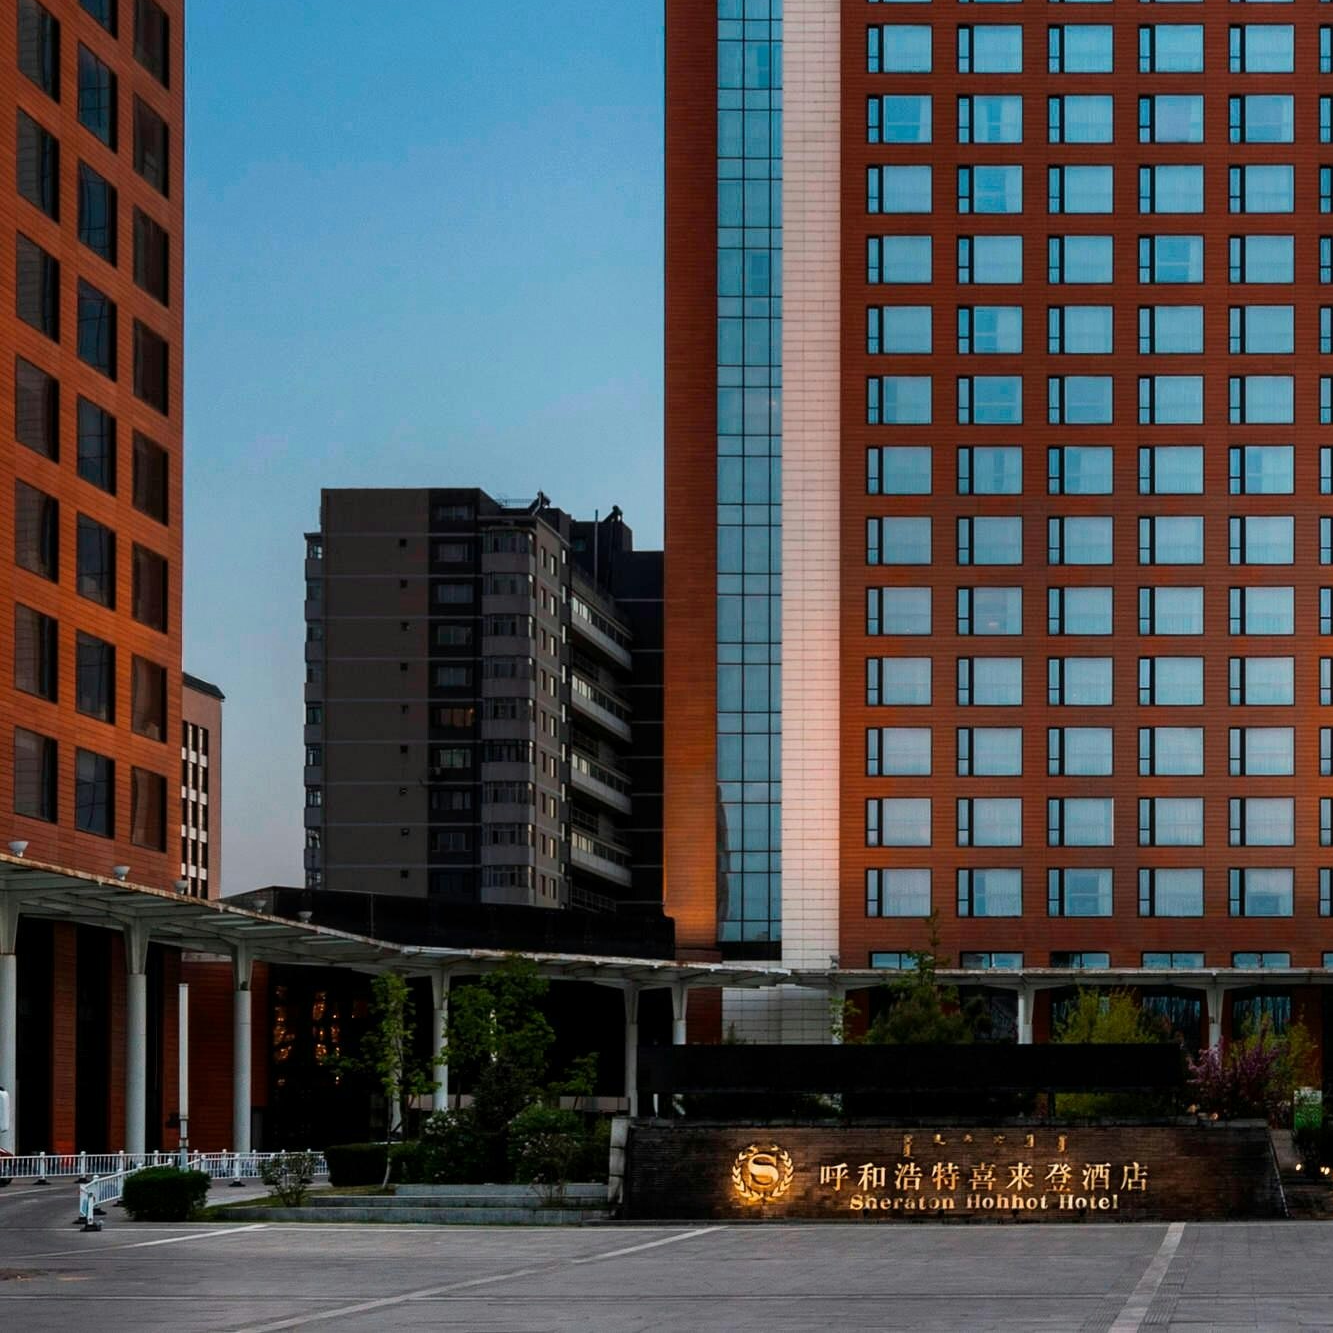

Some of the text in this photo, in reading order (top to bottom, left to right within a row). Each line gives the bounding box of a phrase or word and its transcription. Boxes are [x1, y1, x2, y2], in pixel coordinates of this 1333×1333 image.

[747, 1153, 780, 1189] S
[820, 1162, 1149, 1193] 呼和浩特喜来登酒店
[849, 1194, 1119, 1210] Sheraton Hohhot Hotel
